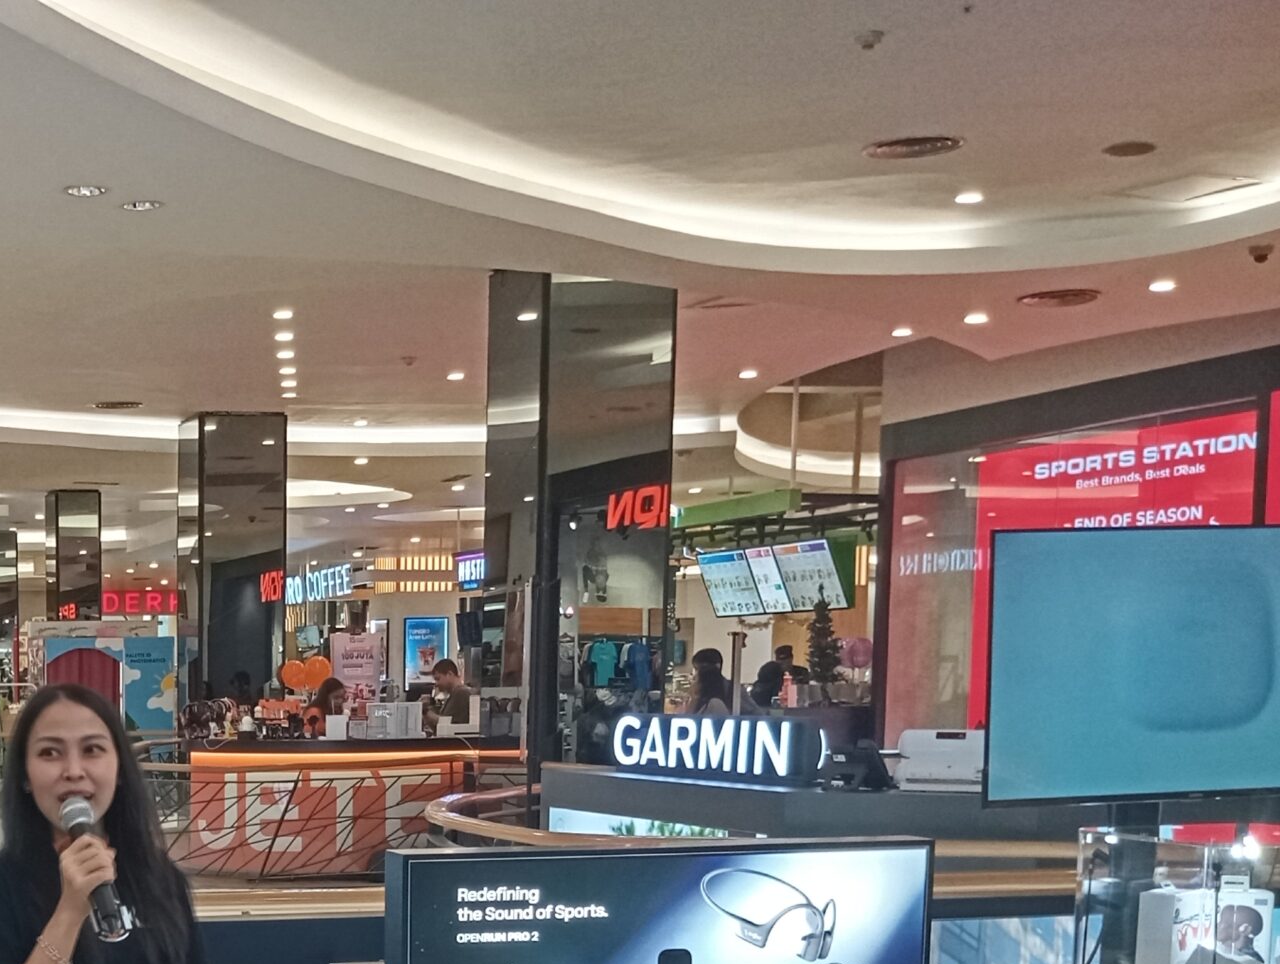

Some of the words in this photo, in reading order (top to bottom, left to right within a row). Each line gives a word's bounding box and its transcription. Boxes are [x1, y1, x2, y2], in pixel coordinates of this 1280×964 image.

[1034, 450, 1136, 479] SPORTS
[1142, 432, 1257, 463] STATION
[1076, 478, 1098, 490] Best
[1101, 472, 1142, 487] Brands,
[1145, 468, 1170, 480] Best
[1173, 463, 1206, 477] Deals
[1074, 516, 1107, 527] END
[1110, 513, 1132, 527] OF
[1136, 505, 1203, 525] SEASON
[285, 576, 303, 604] RO
[306, 564, 353, 601] COFFEE
[613, 715, 790, 777] GARMIN
[457, 886, 540, 904] Redefining
[457, 907, 482, 922] the
[485, 905, 533, 921] Sound
[535, 904, 554, 920] of
[555, 903, 609, 922] Sports.
[456, 932, 507, 943] OPENRUN
[508, 931, 530, 943] PRO
[531, 931, 539, 942] 2
